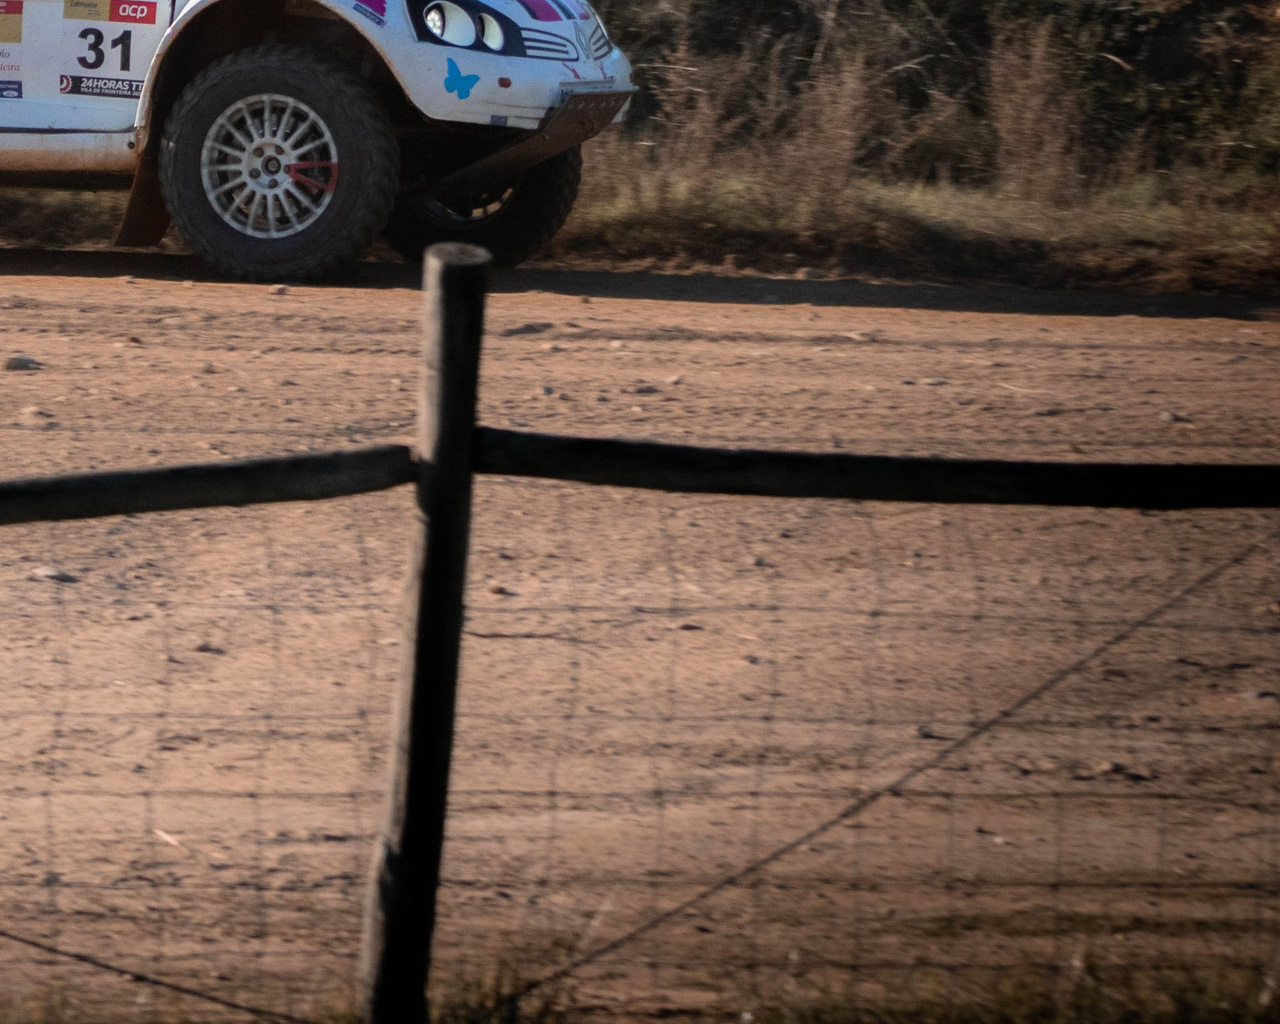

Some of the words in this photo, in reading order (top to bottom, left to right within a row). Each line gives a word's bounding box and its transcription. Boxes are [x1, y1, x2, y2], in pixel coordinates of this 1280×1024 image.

[119, 4, 148, 18] acp
[76, 28, 132, 72] 31
[80, 78, 130, 90] 24HORAS
